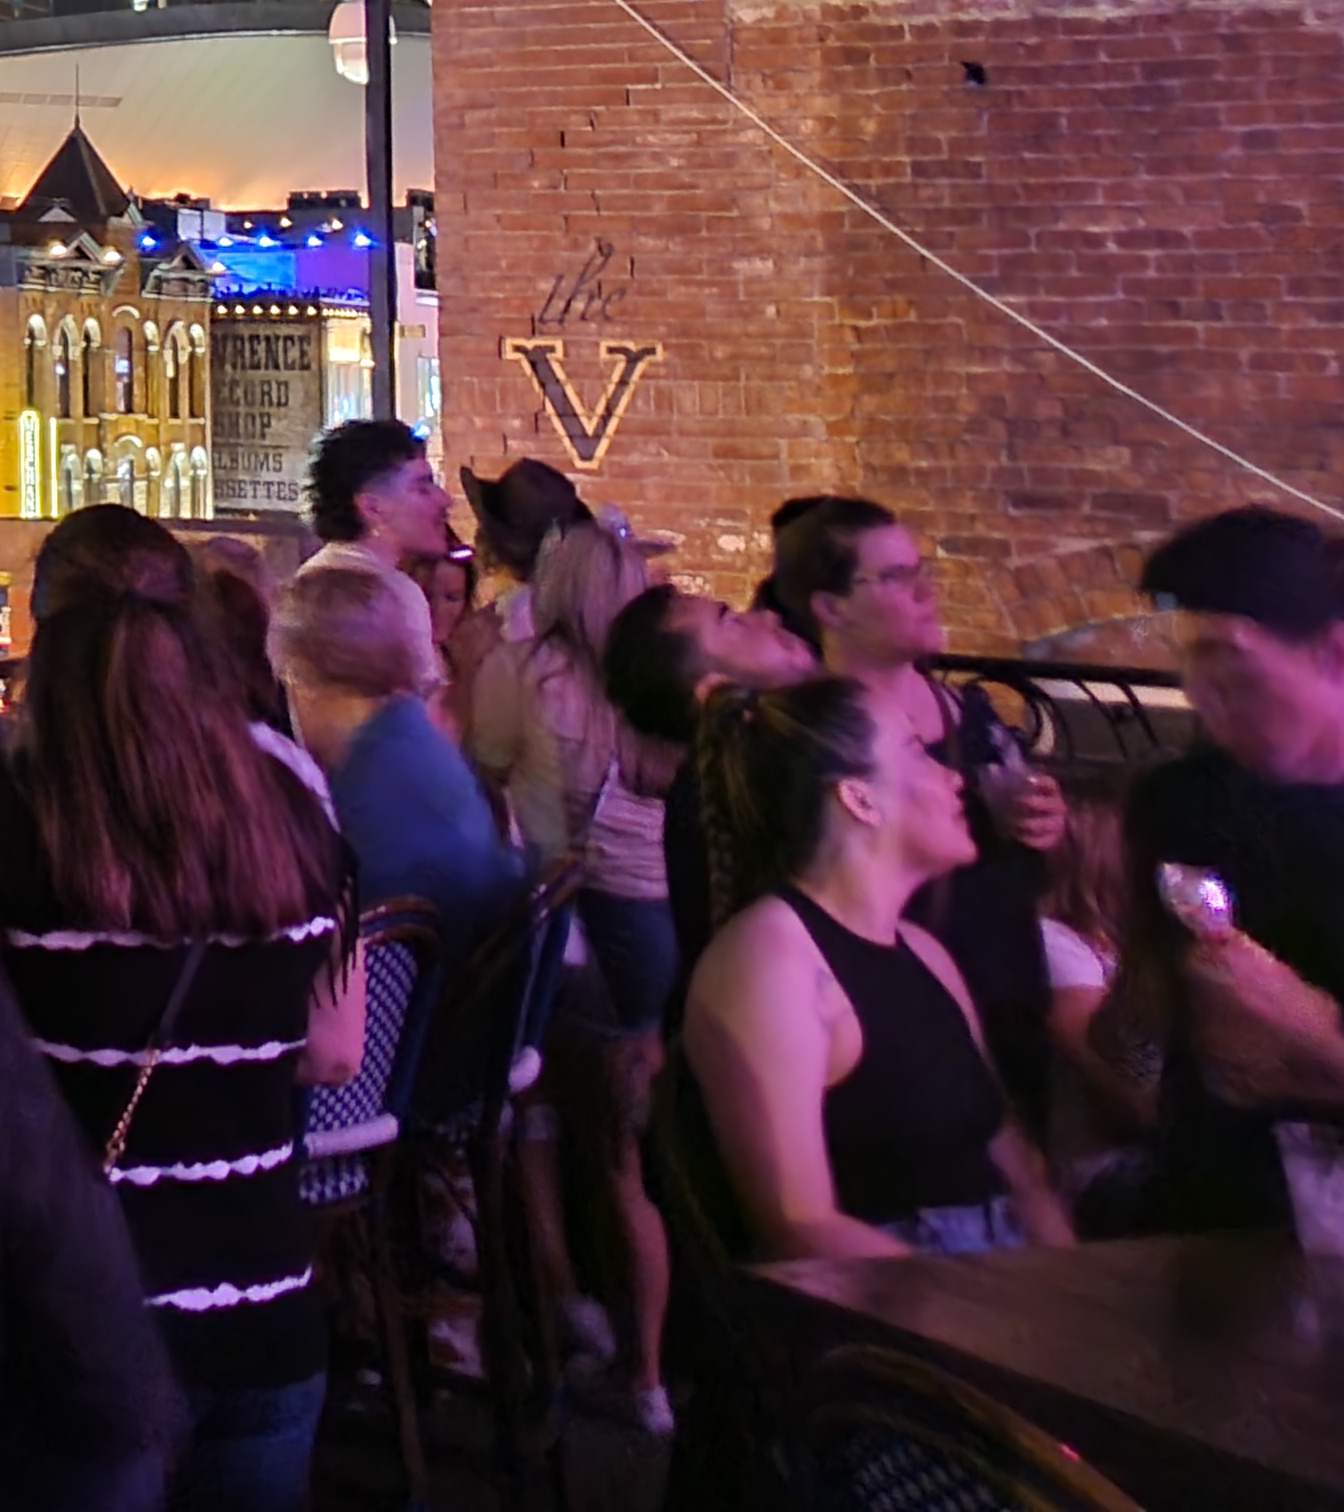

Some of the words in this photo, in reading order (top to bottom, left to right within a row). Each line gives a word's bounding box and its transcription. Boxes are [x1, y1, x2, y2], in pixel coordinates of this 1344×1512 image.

[538, 237, 627, 326] the
[215, 411, 272, 440] SHOP
[504, 337, 663, 470] V
